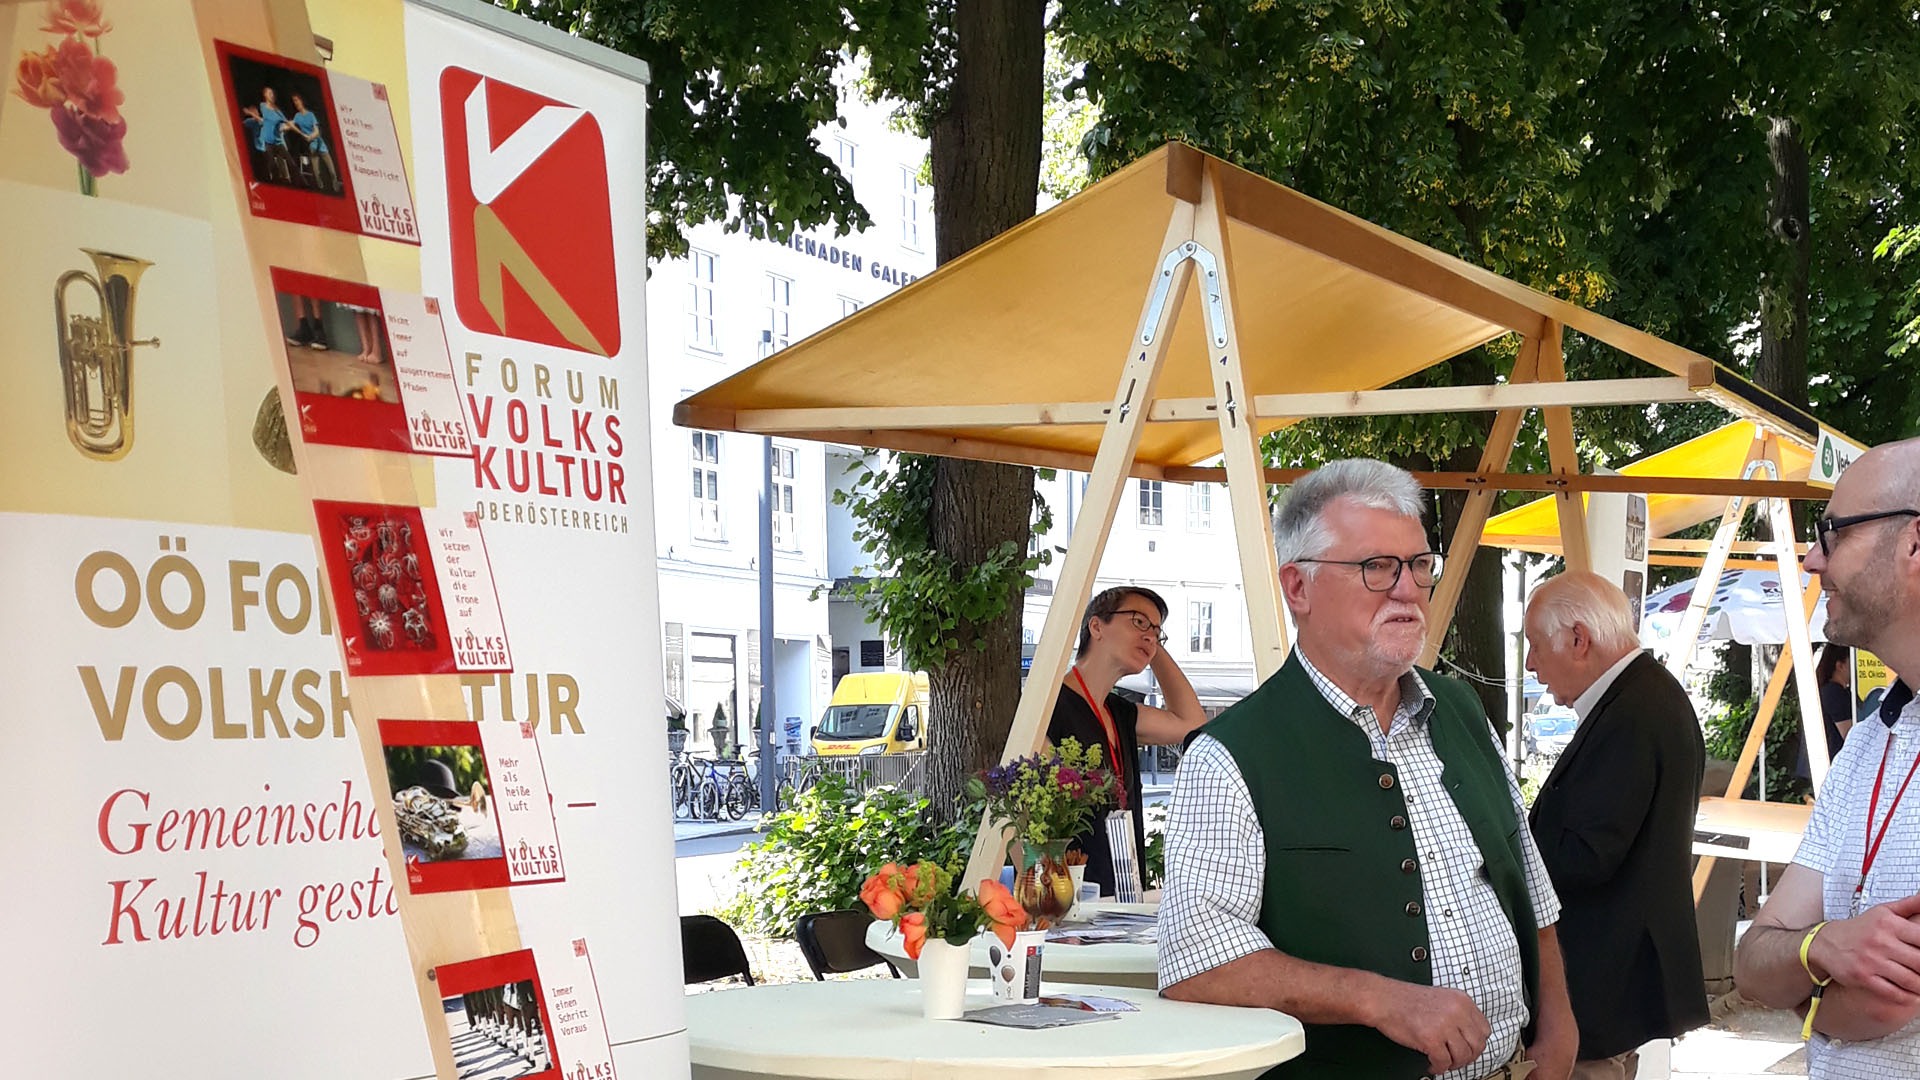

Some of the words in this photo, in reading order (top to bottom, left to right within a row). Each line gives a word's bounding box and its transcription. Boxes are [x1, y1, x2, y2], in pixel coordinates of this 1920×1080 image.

[364, 214, 414, 237] KULTUR
[744, 219, 862, 273] ENADEN
[465, 352, 620, 411] FORUM
[466, 393, 623, 458] VOLKS
[414, 432, 467, 450] KULTUR
[472, 444, 627, 505] KULTUR
[476, 500, 628, 534] OBERÖSTERREICH
[439, 528, 453, 538] Wir
[443, 543, 470, 552] setzen
[446, 556, 460, 564] der
[449, 568, 476, 578] Kultur
[74, 534, 206, 631] OÖ
[453, 582, 467, 591] die
[456, 595, 479, 605] Krone
[459, 608, 472, 617] auf
[458, 651, 507, 665] KULTUR
[499, 758, 519, 768] Mehr
[503, 772, 518, 782] als
[506, 786, 530, 797] heiße
[508, 801, 529, 811] Luft
[512, 860, 559, 876] KULTUR
[101, 871, 282, 946] Kultur
[552, 985, 573, 997] Immer
[555, 999, 577, 1010] einen
[558, 1009, 589, 1023] Schritt
[561, 1024, 587, 1036] Voraus
